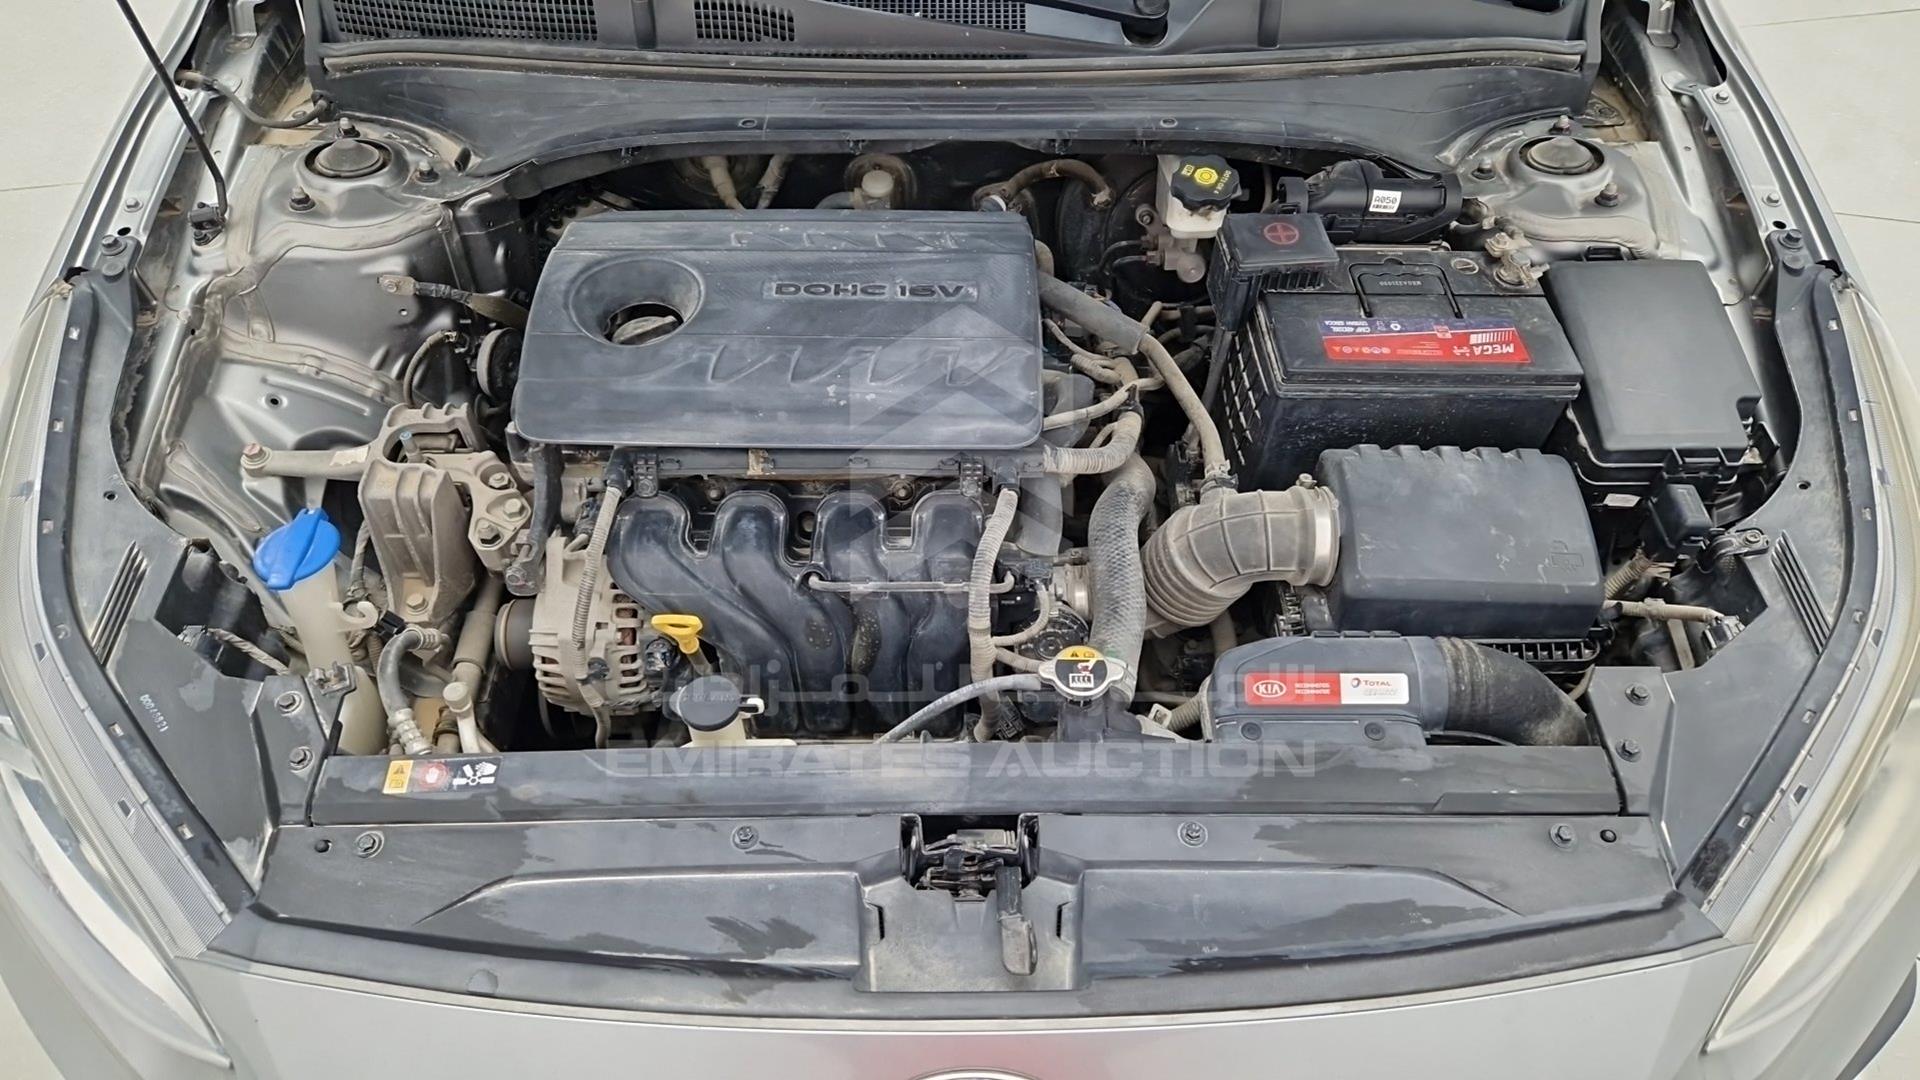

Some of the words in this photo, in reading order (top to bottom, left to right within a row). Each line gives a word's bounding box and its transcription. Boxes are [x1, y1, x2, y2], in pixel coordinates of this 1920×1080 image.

[774, 282, 888, 298] DOHC
[899, 283, 965, 298] 16V
[1473, 343, 1515, 356] MEGA
[1257, 683, 1282, 695] KIA
